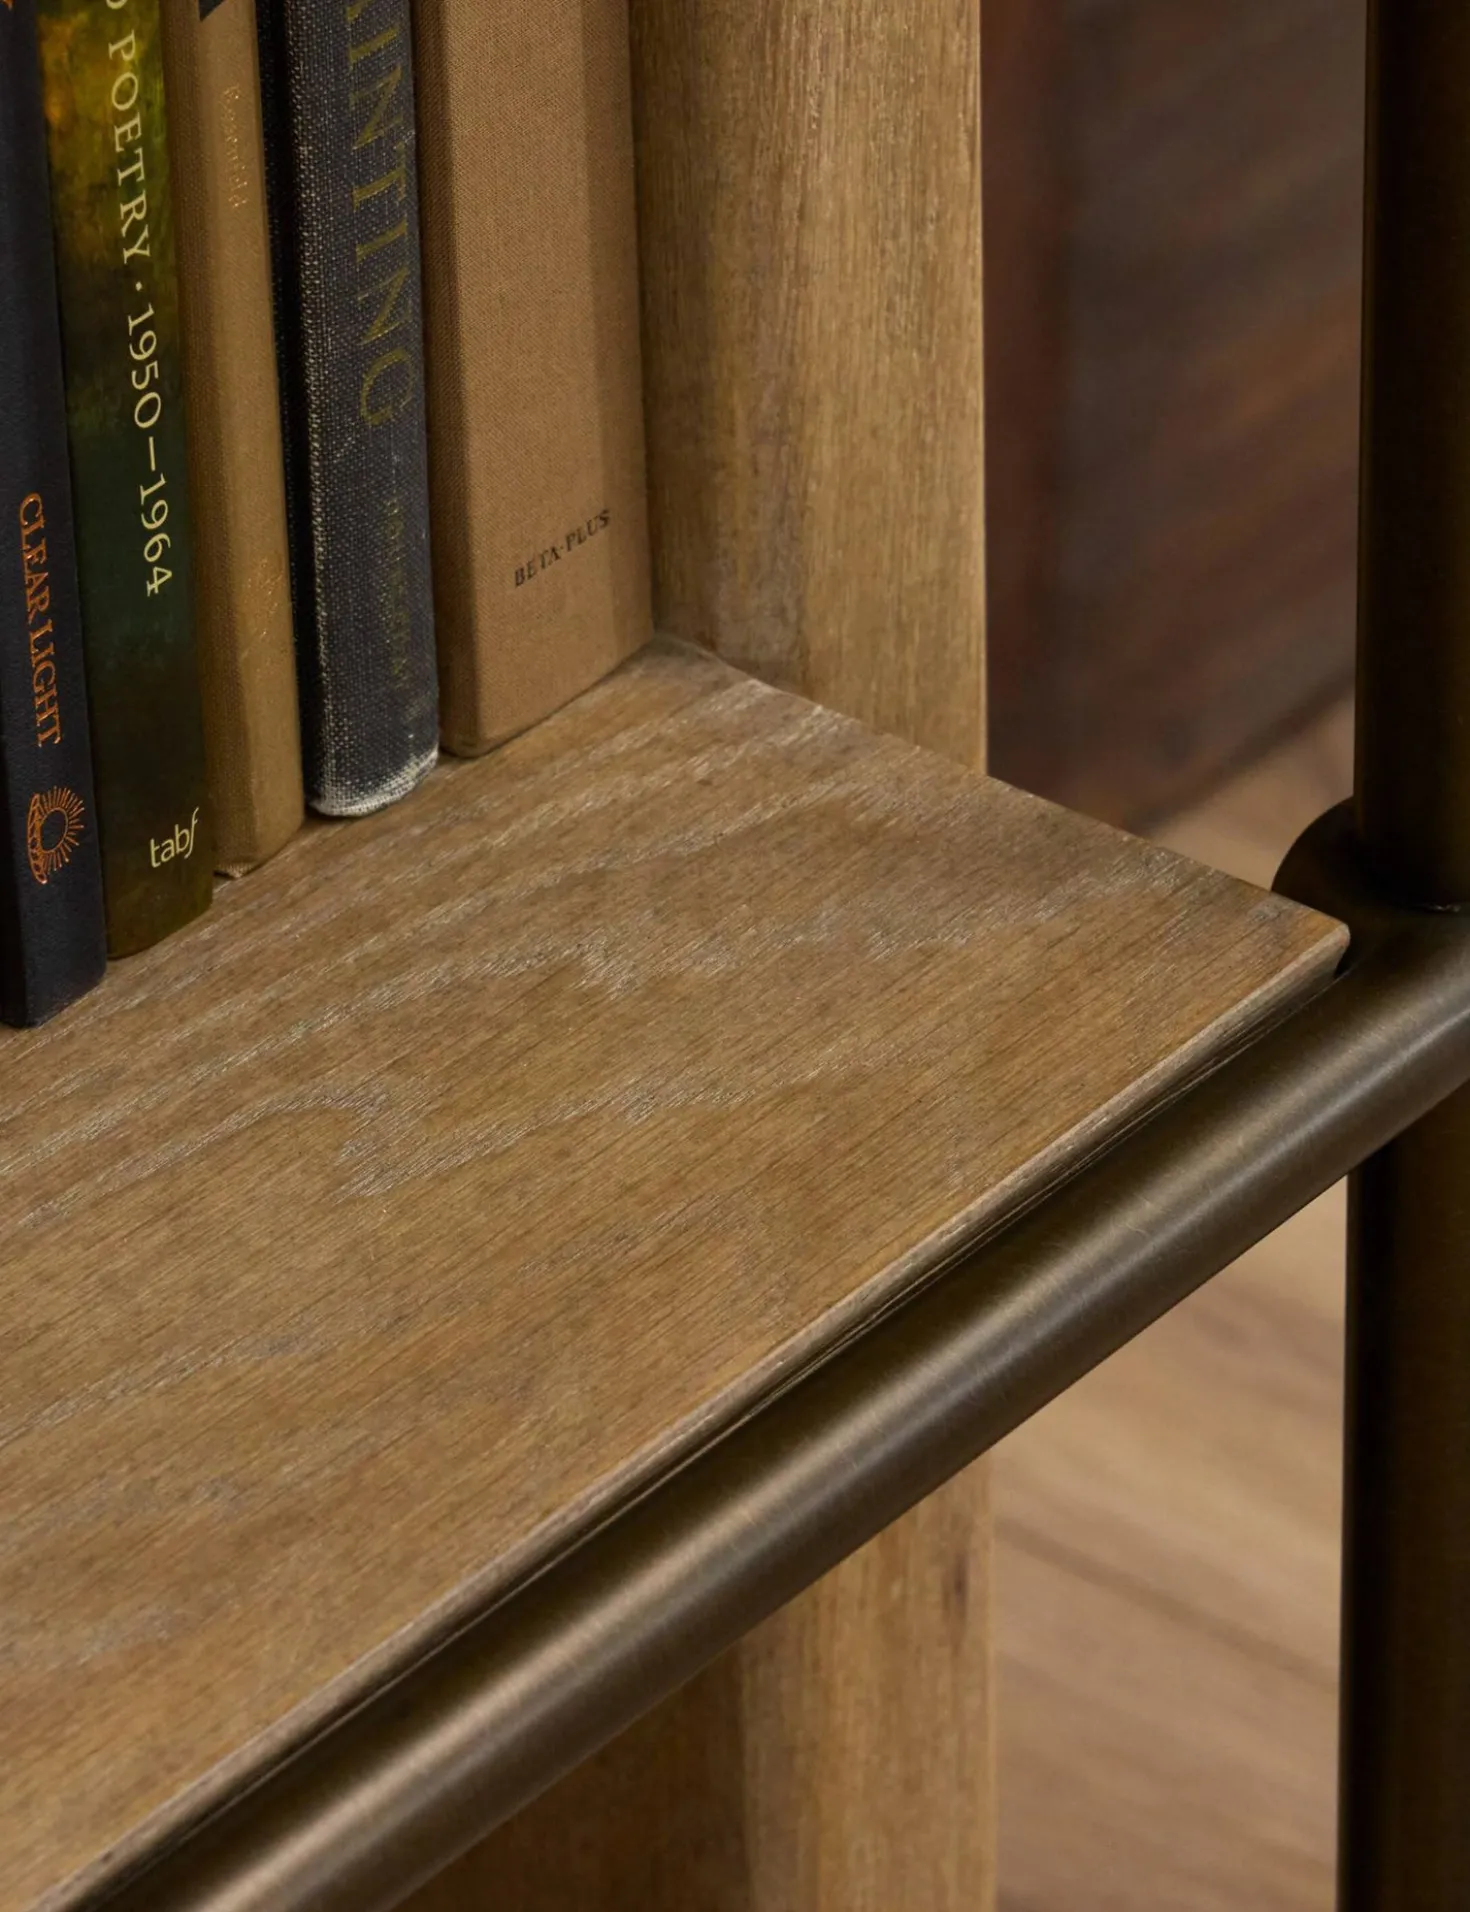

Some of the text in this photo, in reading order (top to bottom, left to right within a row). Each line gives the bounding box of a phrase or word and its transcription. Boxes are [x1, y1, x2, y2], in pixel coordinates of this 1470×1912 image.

[108, 29, 151, 265] POETRY
[19, 492, 62, 748] CLEAR LIGHT
[150, 806, 199, 868] tabf
